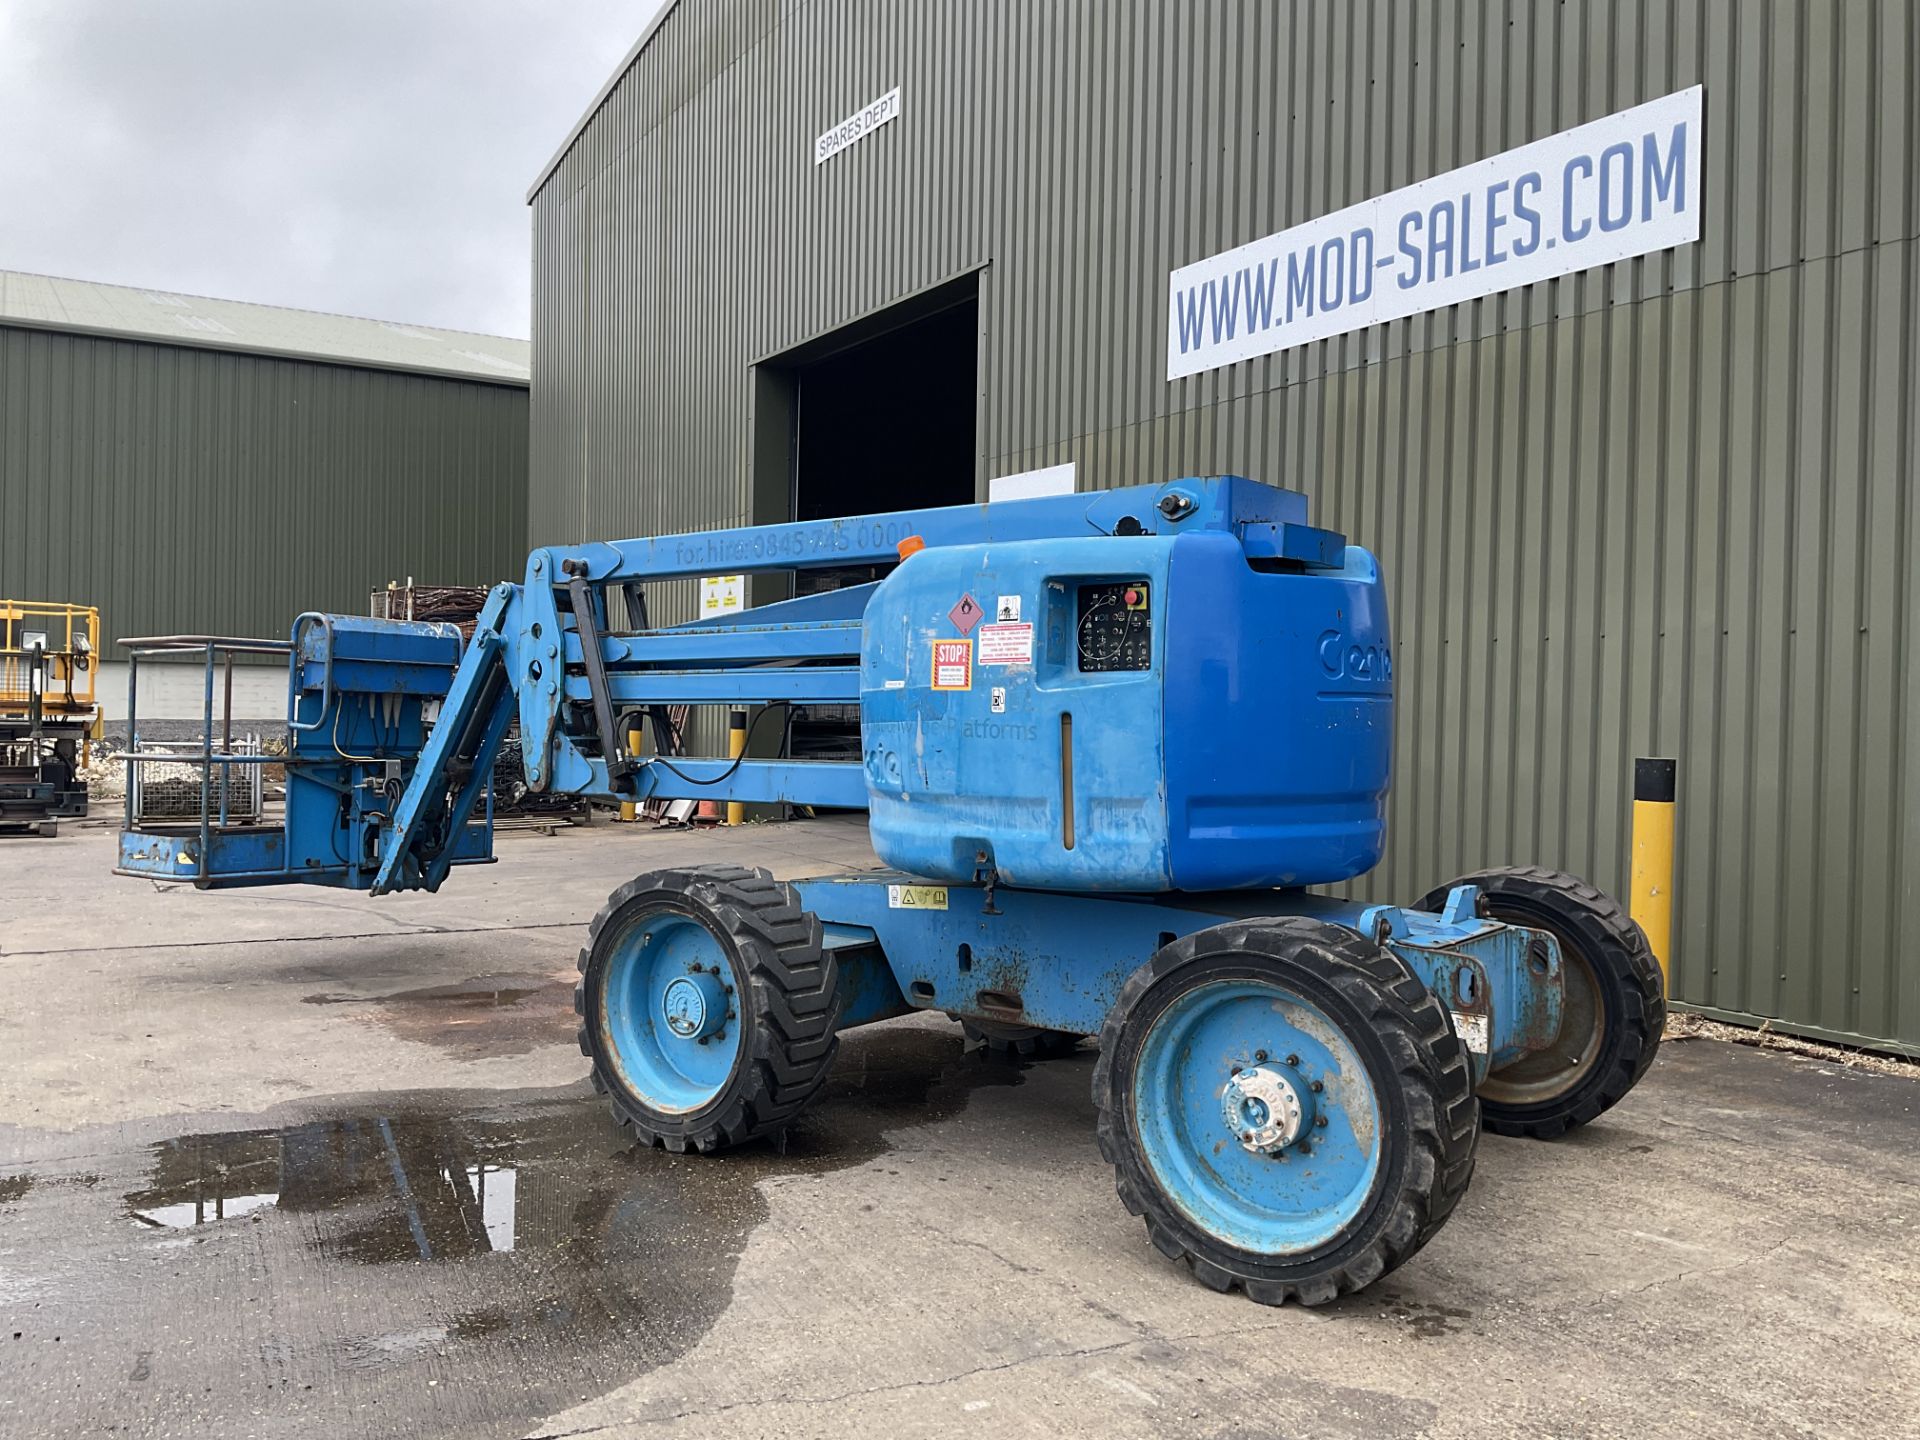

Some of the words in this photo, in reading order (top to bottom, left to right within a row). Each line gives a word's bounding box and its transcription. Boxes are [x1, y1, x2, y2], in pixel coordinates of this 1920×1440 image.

[819, 117, 862, 158] SPARES
[864, 94, 896, 130] DEPT
[1176, 121, 1688, 355] WWW.MOD-SALES.COM
[939, 644, 967, 662] STOP!
